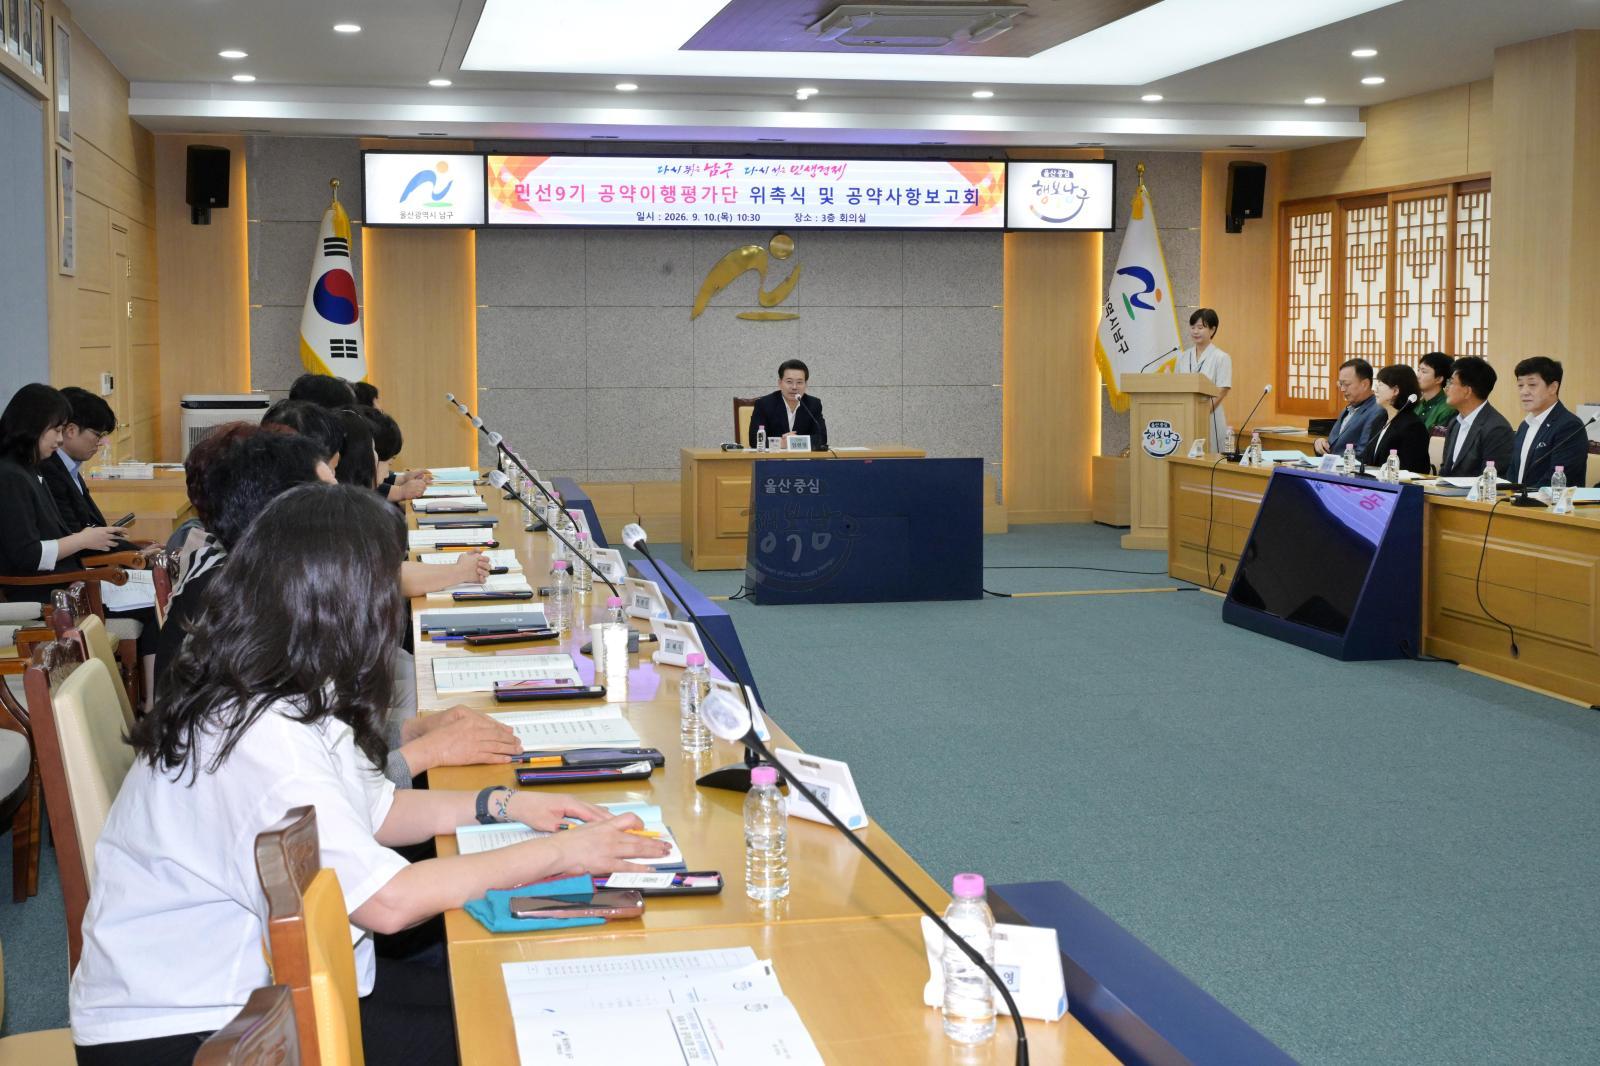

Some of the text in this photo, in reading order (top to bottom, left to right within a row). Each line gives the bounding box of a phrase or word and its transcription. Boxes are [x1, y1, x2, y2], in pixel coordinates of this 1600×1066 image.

[657, 164, 682, 175] 다시
[703, 162, 735, 179] 남구
[744, 165, 770, 176] 다시
[789, 163, 848, 181] 민생경제
[514, 183, 979, 207] 민선9기 공약이행평가단 위촉식 및 공약사항보고회
[399, 209, 455, 221] 울산광역시 남구
[636, 211, 655, 222] 일시
[664, 212, 688, 222] 2026.
[692, 212, 700, 222] 9.
[737, 213, 761, 222] 10:30
[794, 212, 813, 223] 장소
[821, 212, 836, 223] 3층
[839, 213, 866, 223] 회의실
[1105, 295, 1130, 354] 역시남구
